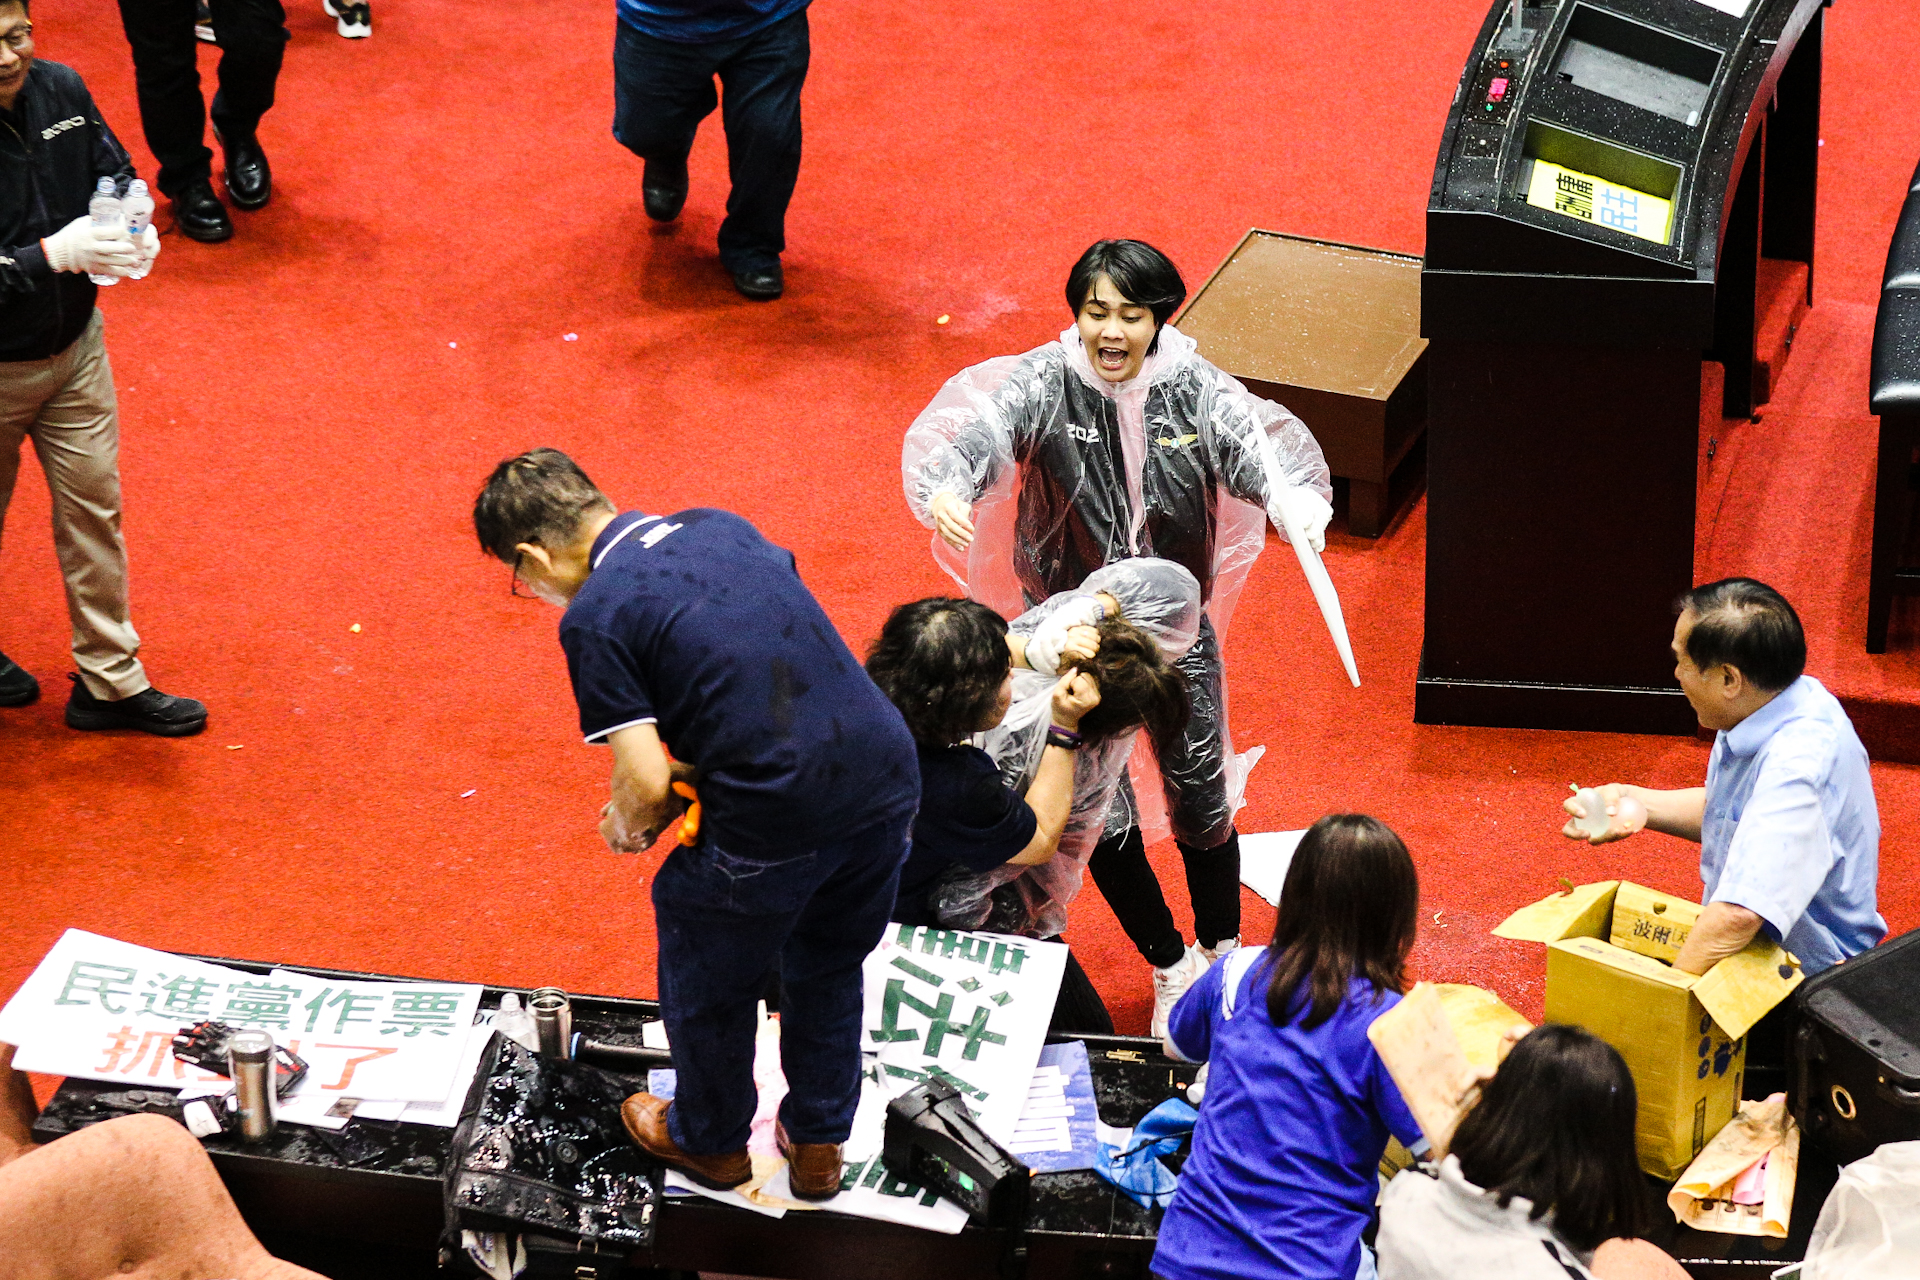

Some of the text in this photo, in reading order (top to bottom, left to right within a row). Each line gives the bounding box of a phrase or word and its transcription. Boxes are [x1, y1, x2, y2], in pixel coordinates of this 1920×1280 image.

[1601, 188, 1638, 233] 民主
[54, 960, 466, 1037] 民進黨作票
[94, 1025, 399, 1091] 抓了
